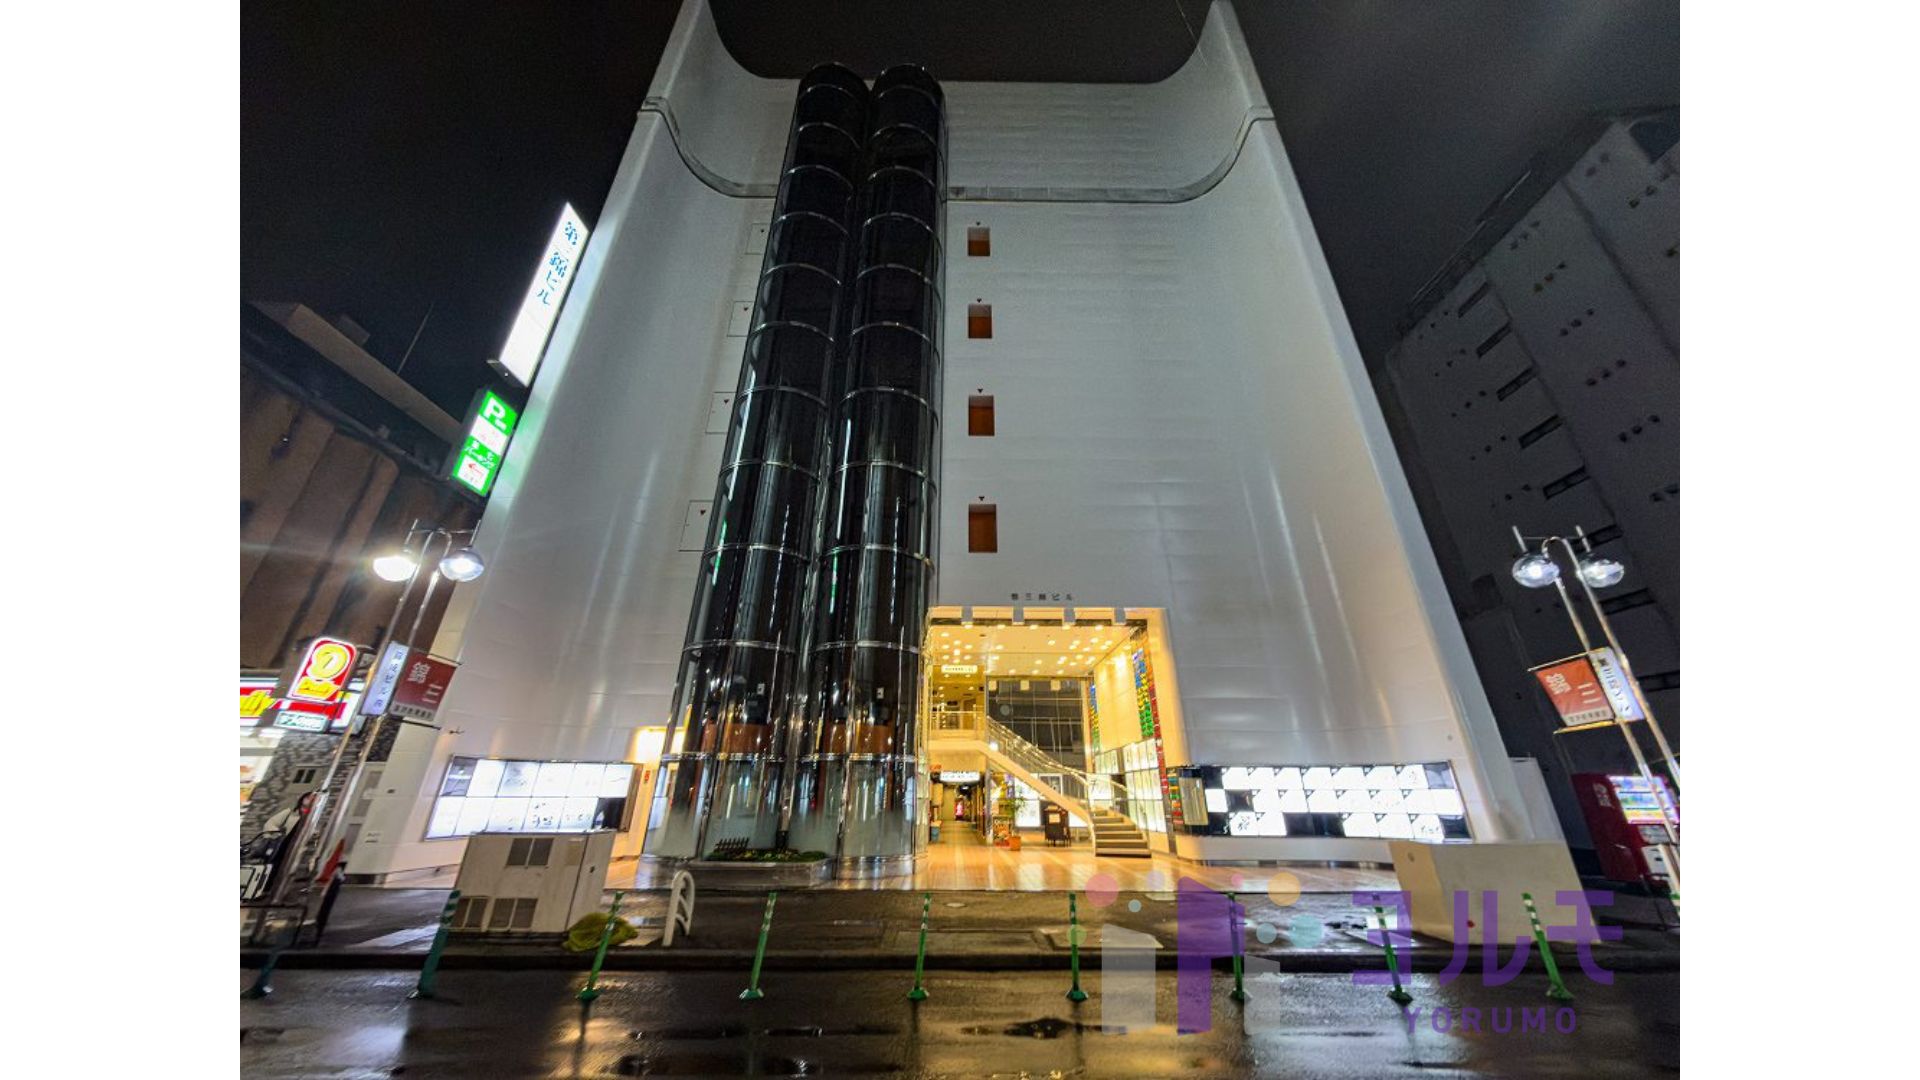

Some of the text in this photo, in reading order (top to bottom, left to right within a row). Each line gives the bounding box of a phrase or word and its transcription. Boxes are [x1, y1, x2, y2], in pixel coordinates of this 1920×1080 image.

[537, 221, 578, 305] 第錦ビル
[483, 397, 506, 419] P
